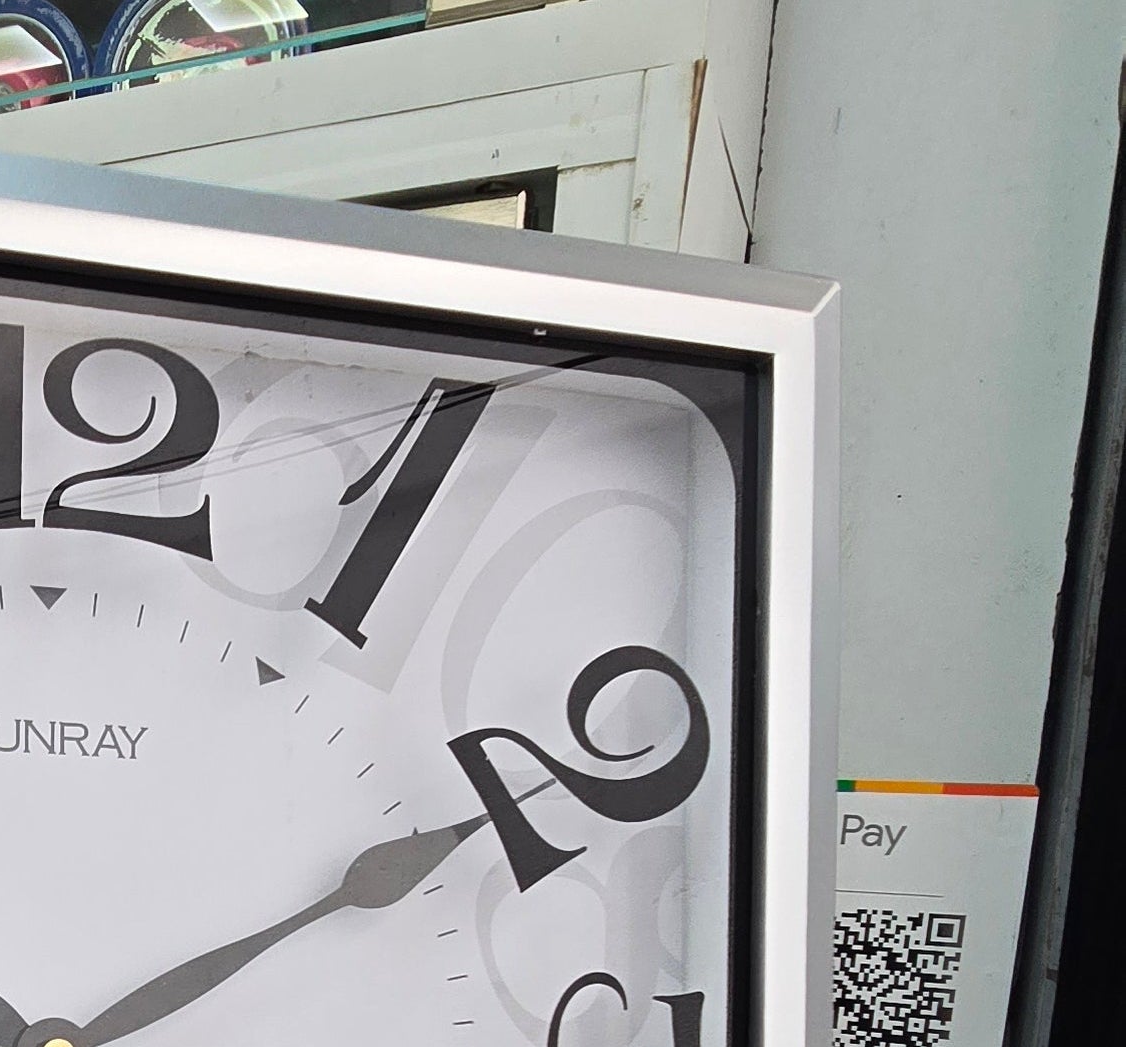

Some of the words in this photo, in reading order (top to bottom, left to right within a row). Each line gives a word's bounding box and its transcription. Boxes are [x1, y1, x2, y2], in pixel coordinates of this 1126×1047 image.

[304, 377, 497, 649] 1
[448, 645, 711, 893] 2
[839, 813, 908, 856] Pay
